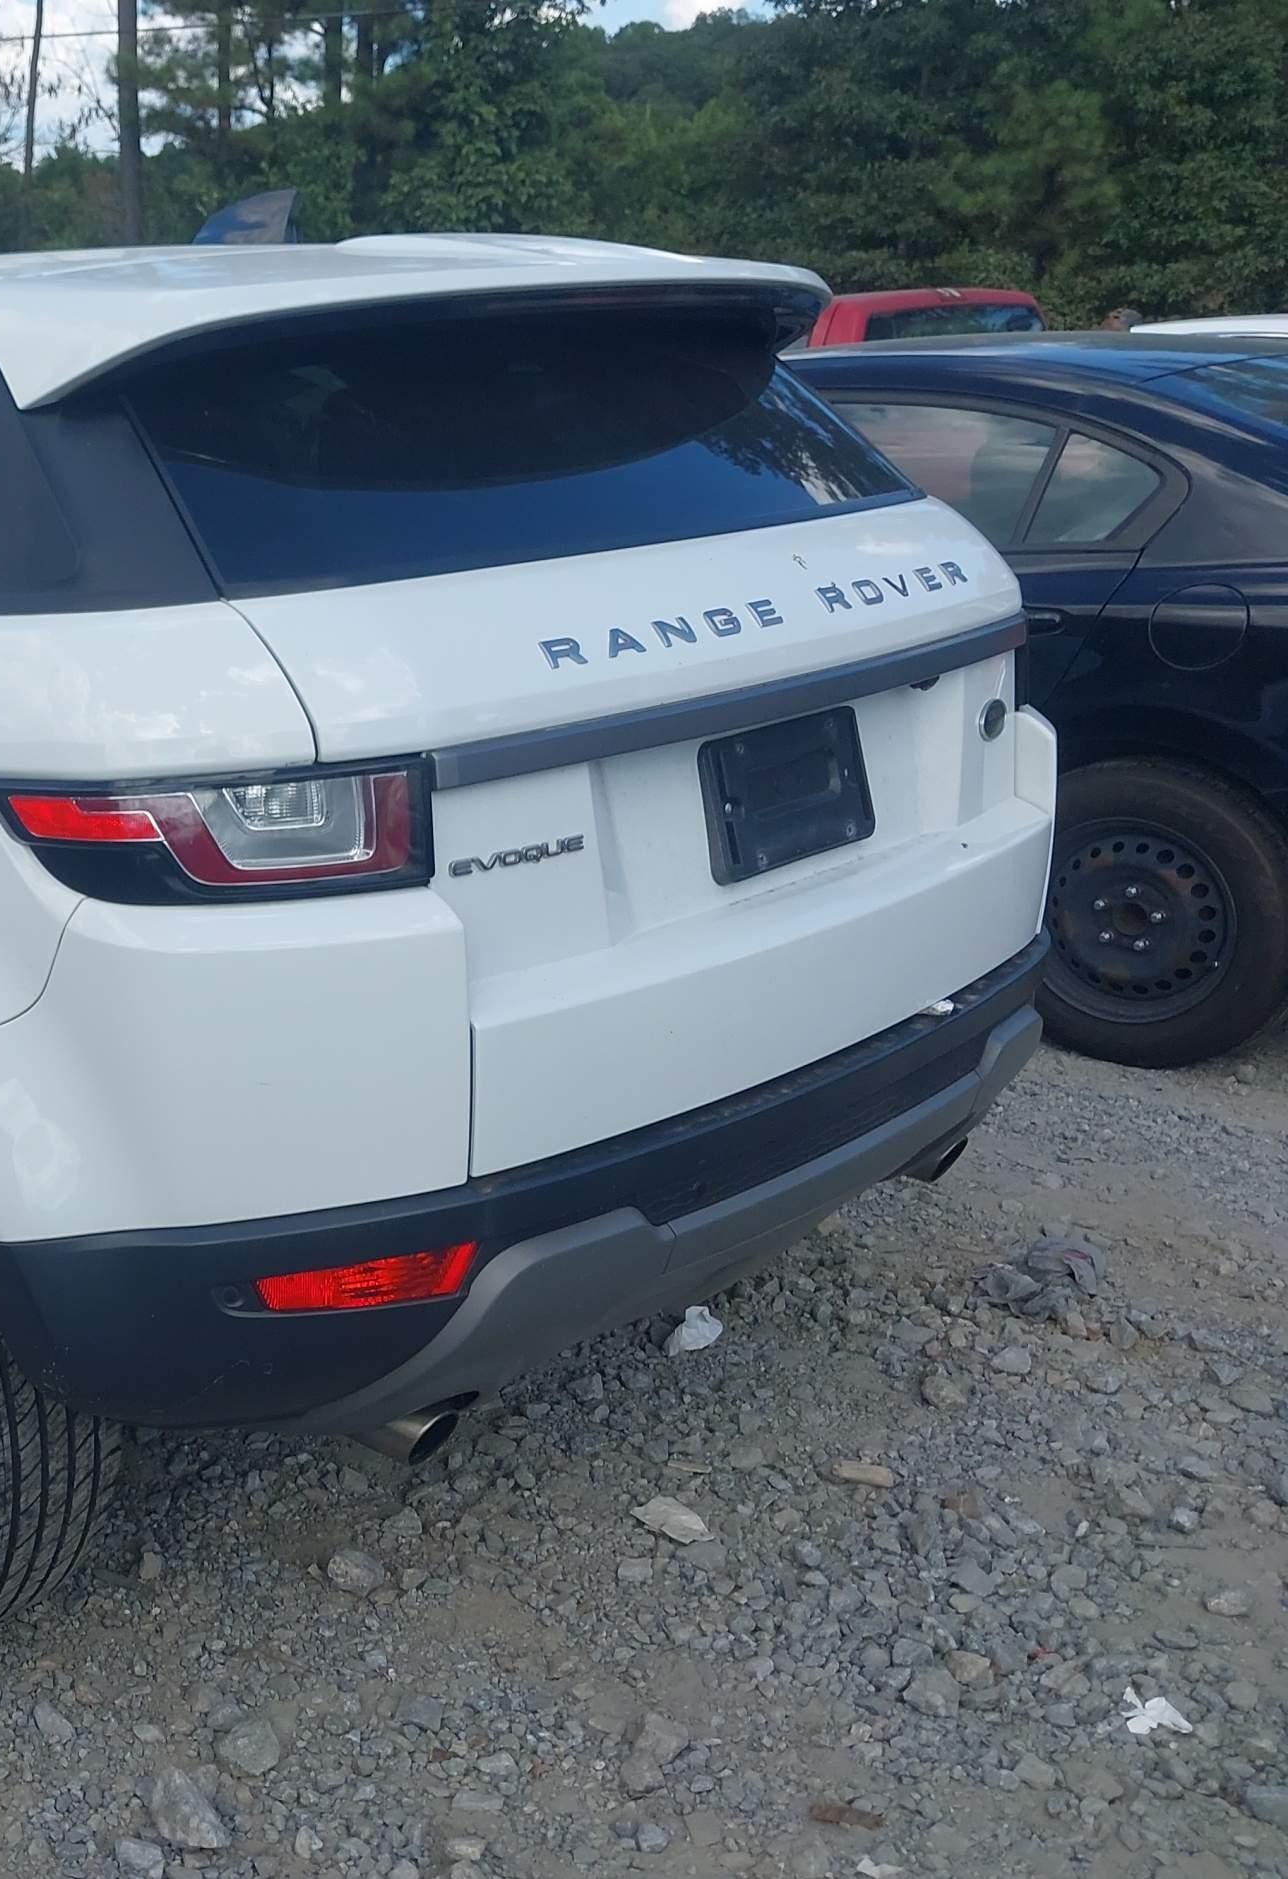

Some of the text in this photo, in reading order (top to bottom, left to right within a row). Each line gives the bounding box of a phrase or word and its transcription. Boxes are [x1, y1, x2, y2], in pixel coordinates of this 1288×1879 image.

[537, 560, 969, 670] RANGE ROVER
[448, 833, 585, 878] EVOQUE
